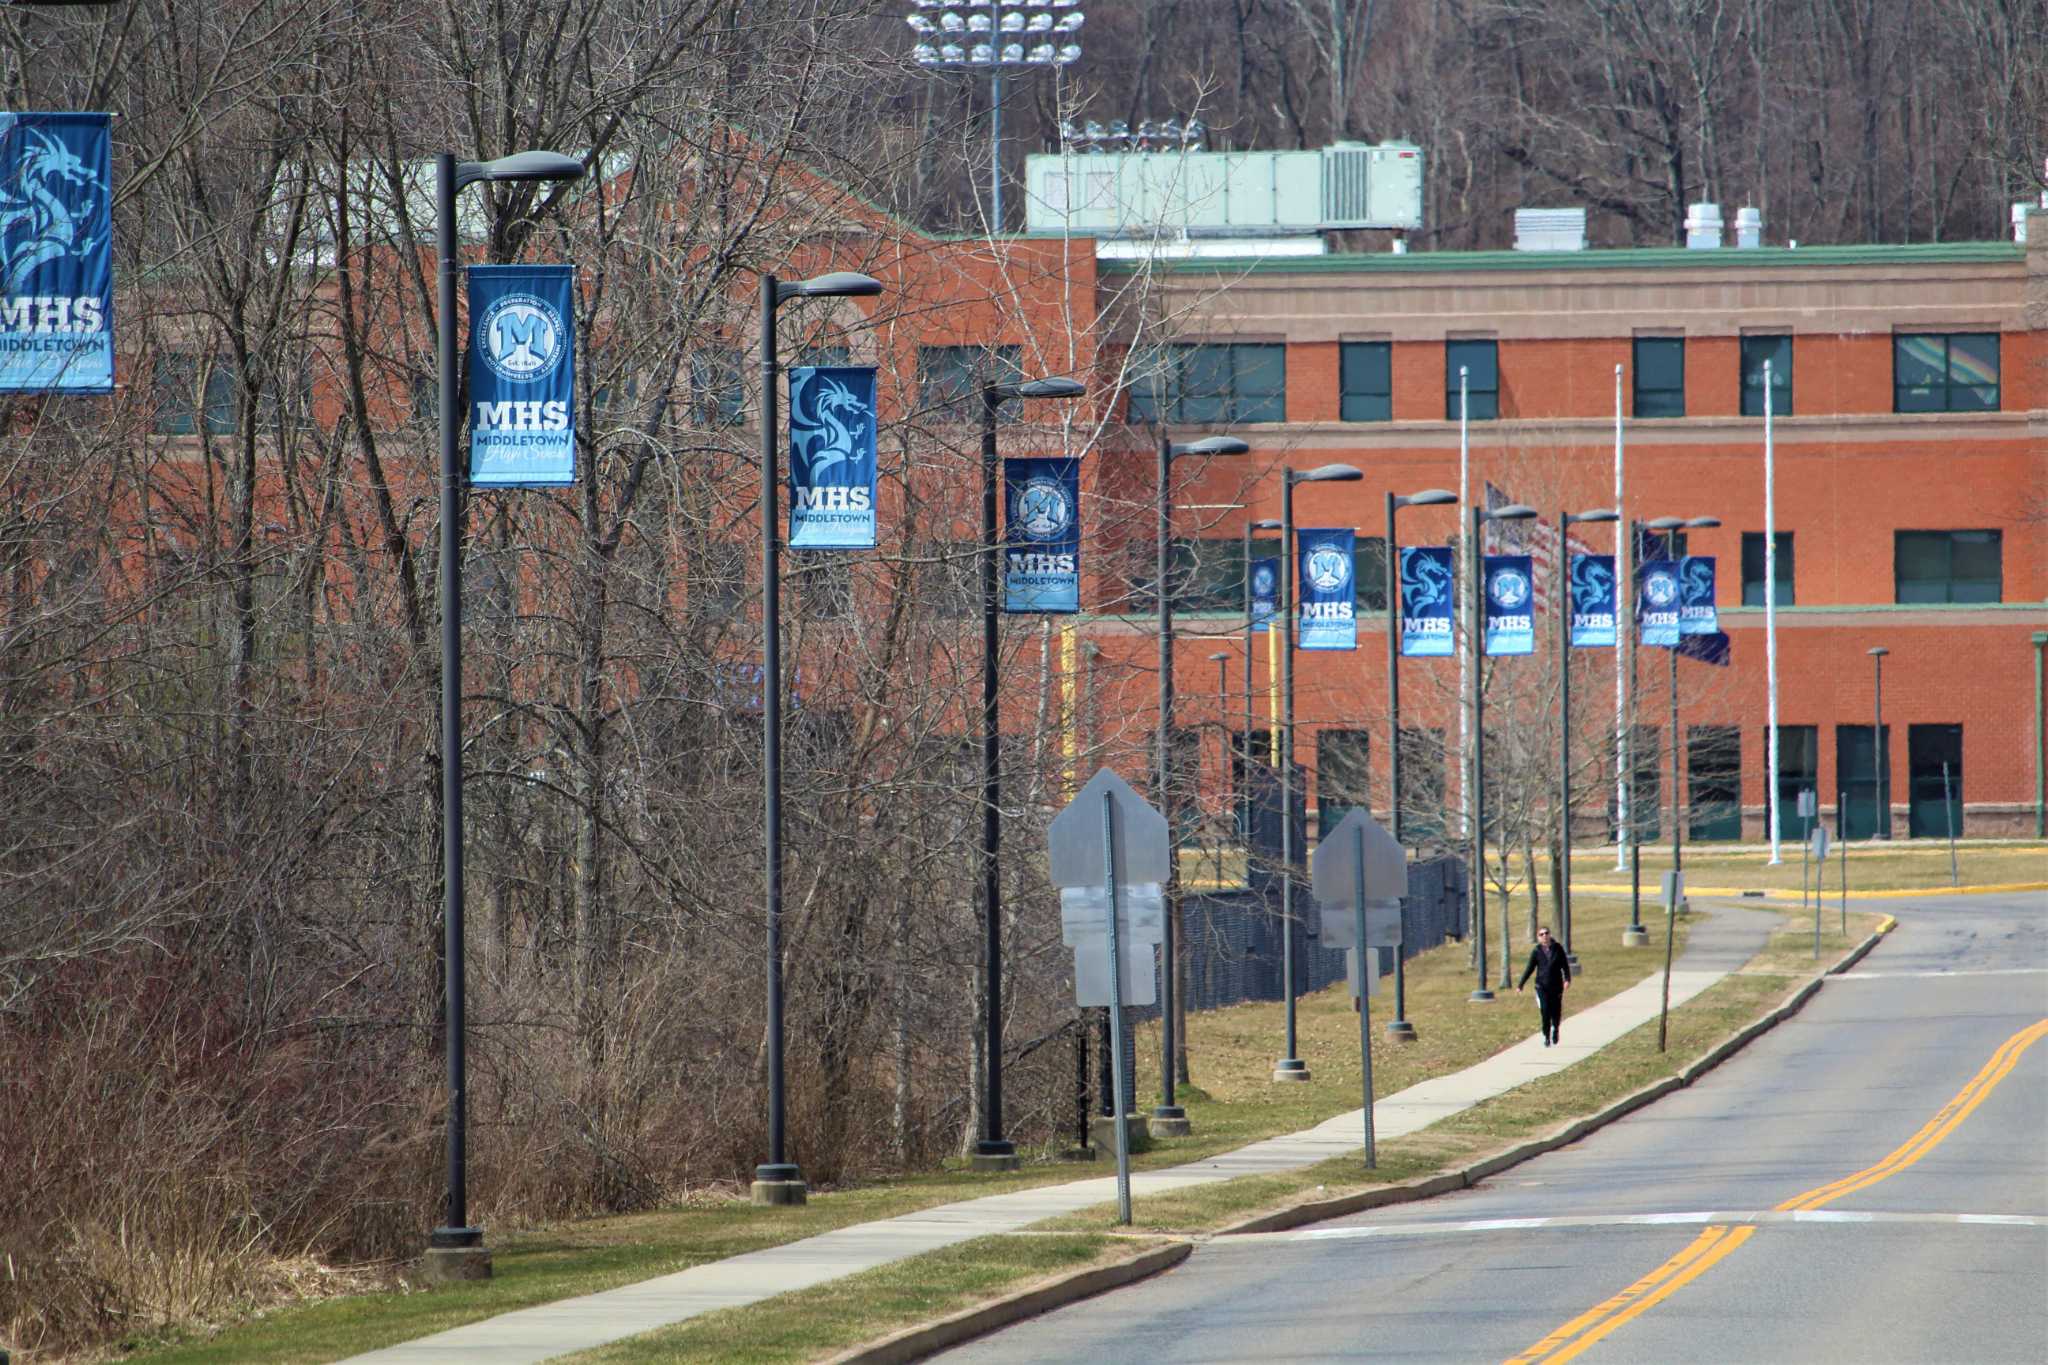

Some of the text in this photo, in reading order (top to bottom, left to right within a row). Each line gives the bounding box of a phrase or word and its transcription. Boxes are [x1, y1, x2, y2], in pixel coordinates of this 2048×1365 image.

[477, 401, 569, 431] MHS
[476, 435, 569, 447] MIDDLETOWN
[795, 486, 870, 511] MHS
[795, 514, 870, 523] MIDDLETOWN
[1009, 553, 1075, 574] MHS
[1301, 601, 1354, 619] MHS
[1681, 605, 1715, 619] MHS
[1403, 617, 1451, 633] MHS
[1488, 615, 1531, 631] MHS
[1573, 614, 1614, 628] MHS
[1642, 611, 1679, 626] MHS
